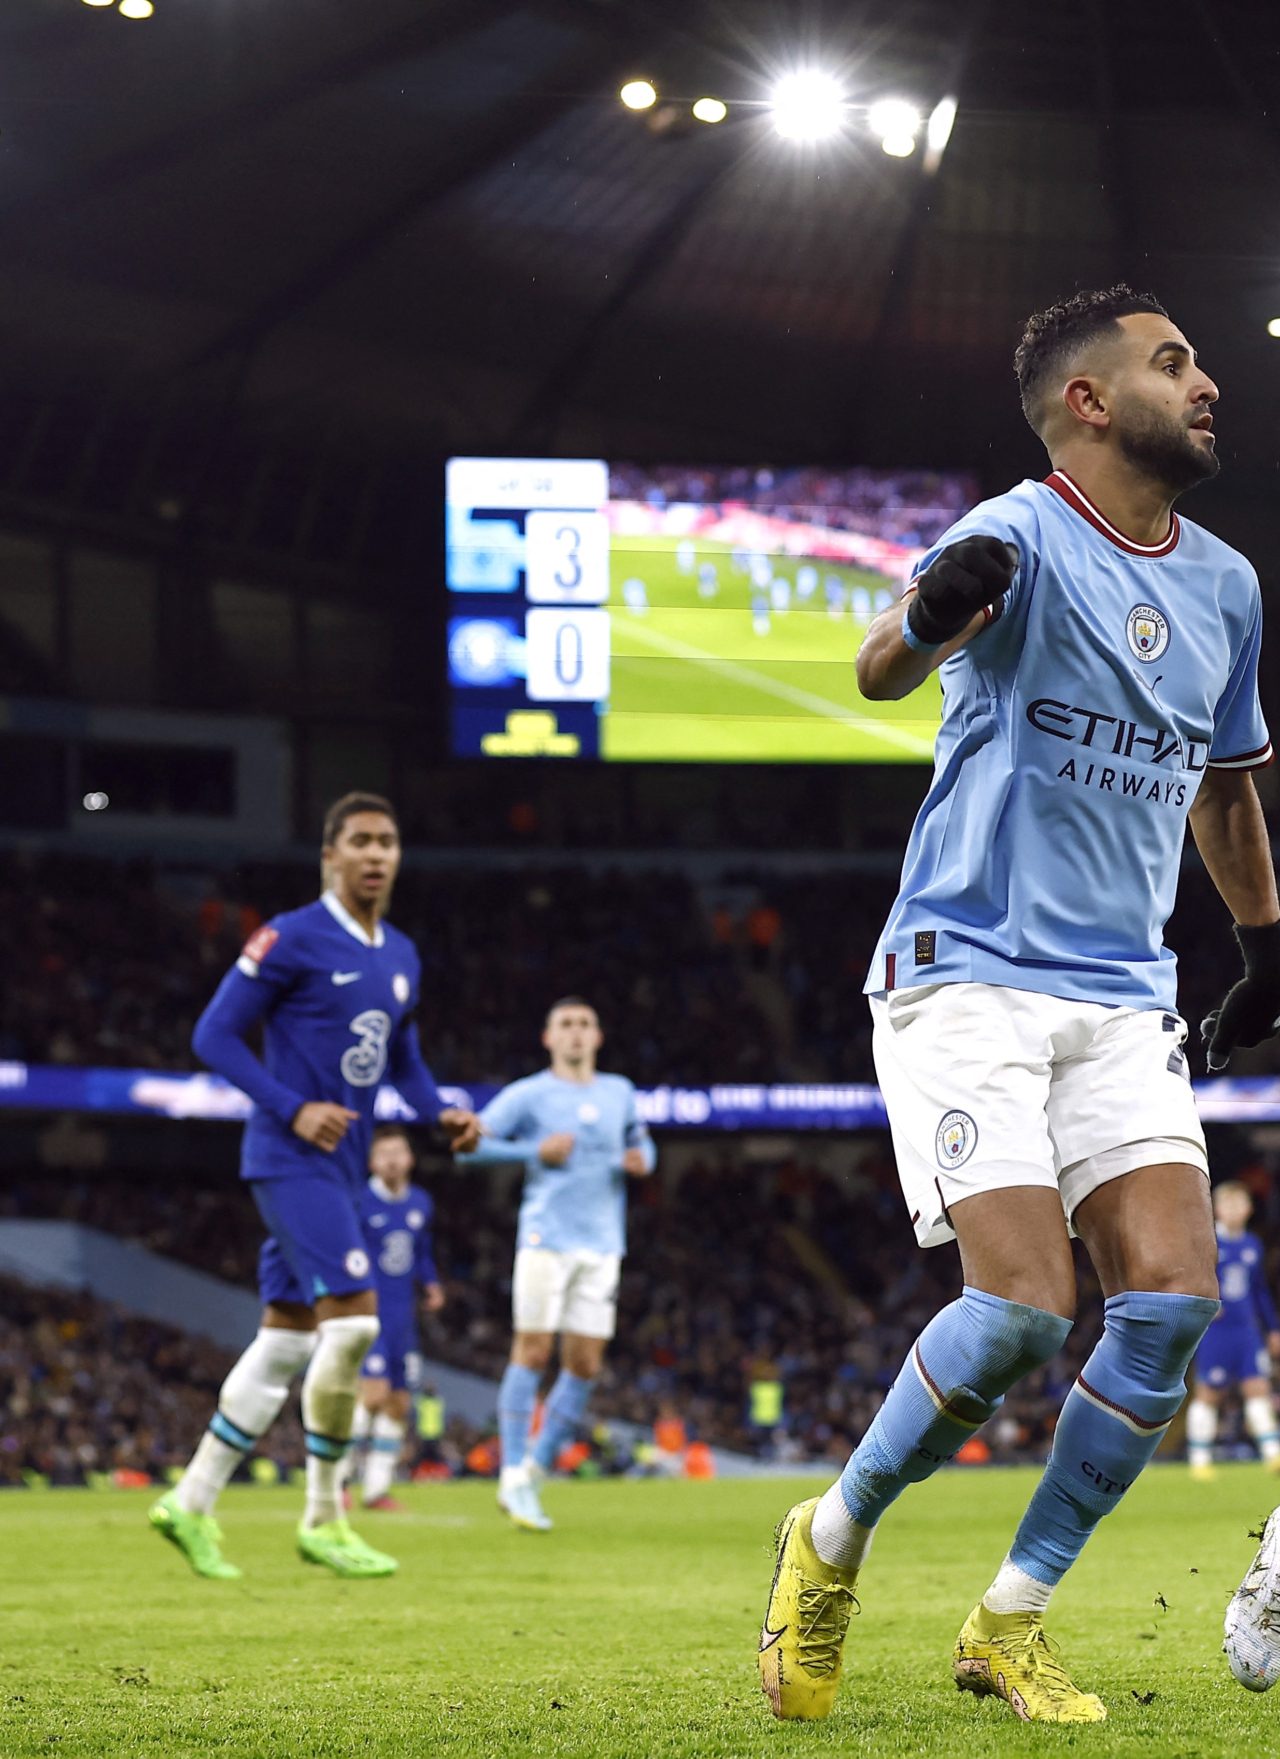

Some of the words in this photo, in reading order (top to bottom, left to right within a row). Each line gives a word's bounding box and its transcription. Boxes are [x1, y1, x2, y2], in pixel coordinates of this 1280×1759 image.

[554, 525, 583, 590] 3
[1130, 607, 1166, 629] MANCHESTER
[554, 622, 583, 687] 0
[1138, 652, 1151, 660] CITY
[1025, 698, 1211, 772] ETIHAD
[1057, 758, 1187, 807] AIRWAYS
